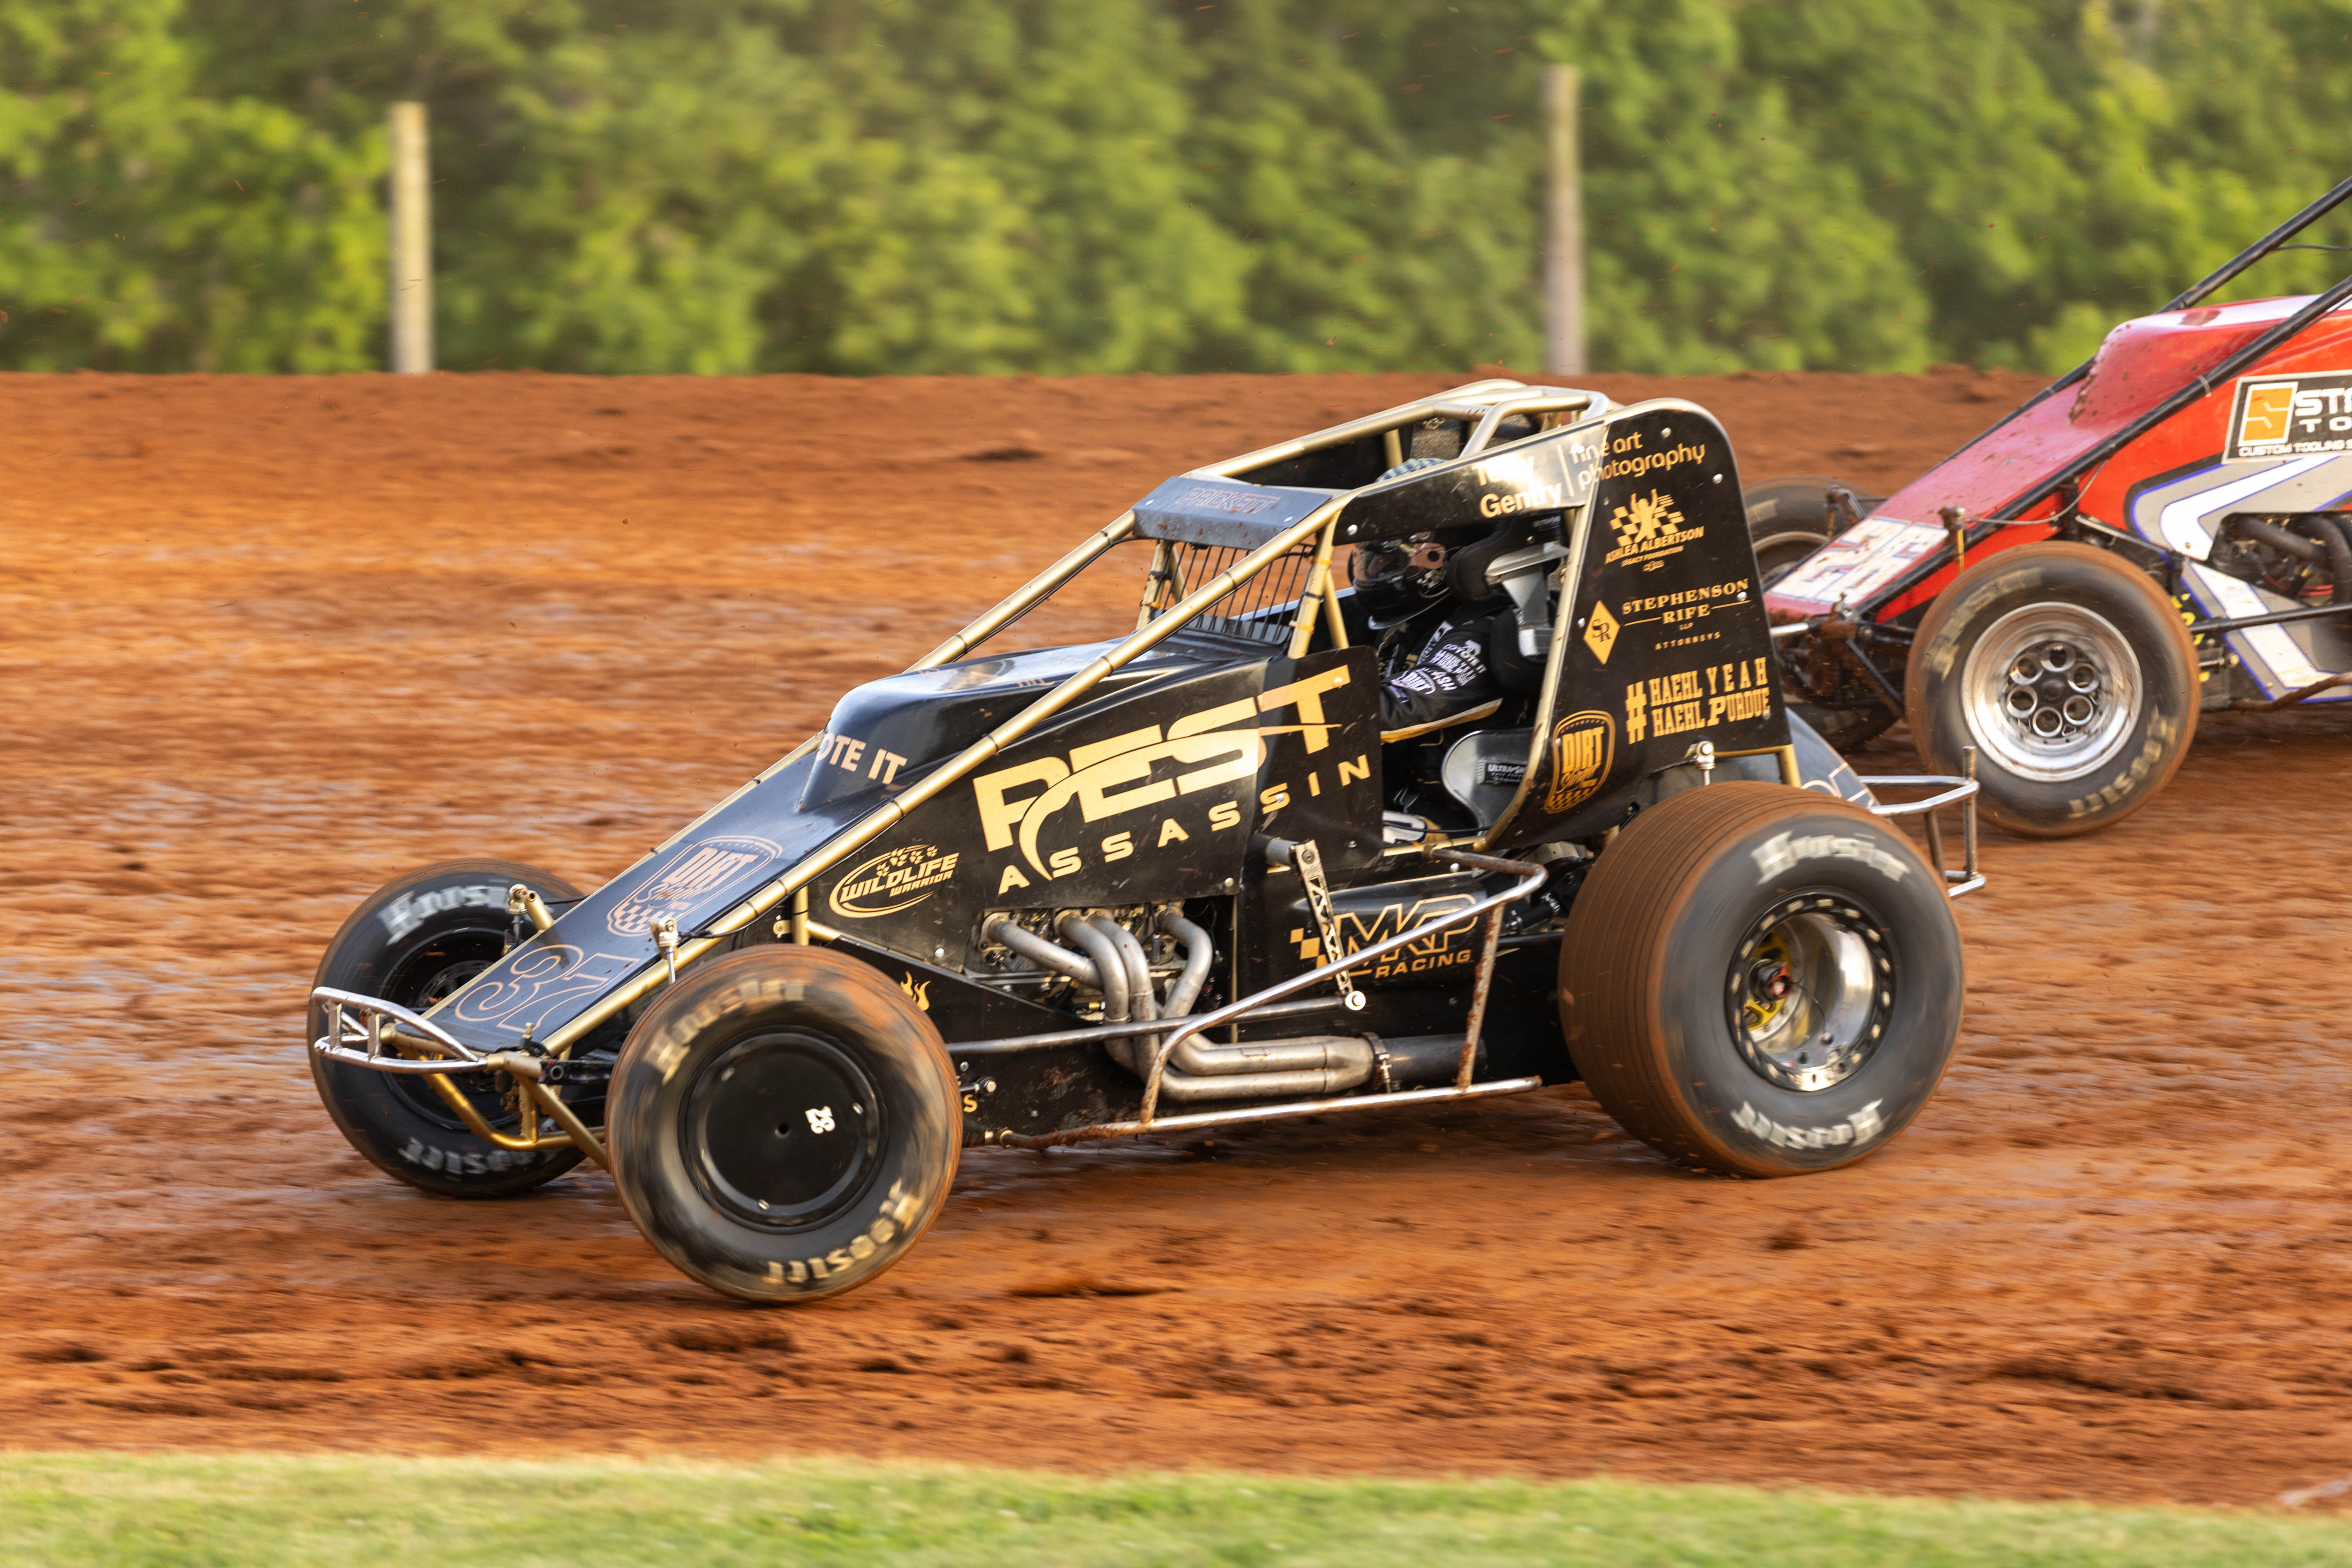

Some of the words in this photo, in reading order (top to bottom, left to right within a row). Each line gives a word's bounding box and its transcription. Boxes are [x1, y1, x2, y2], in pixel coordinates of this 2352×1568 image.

[1569, 442, 1610, 465] fine
[1613, 431, 1643, 454] art
[2238, 443, 2292, 457] CUSTOM
[1578, 443, 1705, 491] photography
[1479, 482, 1562, 518] Gentry
[1640, 525, 1704, 553] ALBERTSON
[1622, 578, 1749, 615] STEPHENSON
[1662, 604, 1710, 624] RIFE
[1655, 631, 1721, 650] ATTORNEYS
[1648, 670, 1703, 707] HAEHL
[1706, 657, 1768, 695] YEAH
[1651, 701, 1706, 737] HAEHL
[868, 748, 908, 784] IT
[974, 664, 1351, 853] PEST
[1562, 726, 1604, 774] DIRT
[998, 754, 1370, 895] ASSASSIN
[661, 846, 759, 888] DIRT
[839, 852, 960, 903] WILDLIFE
[889, 870, 954, 897] WARRIOR
[1375, 950, 1472, 979] RACING
[454, 944, 641, 1033] 37
